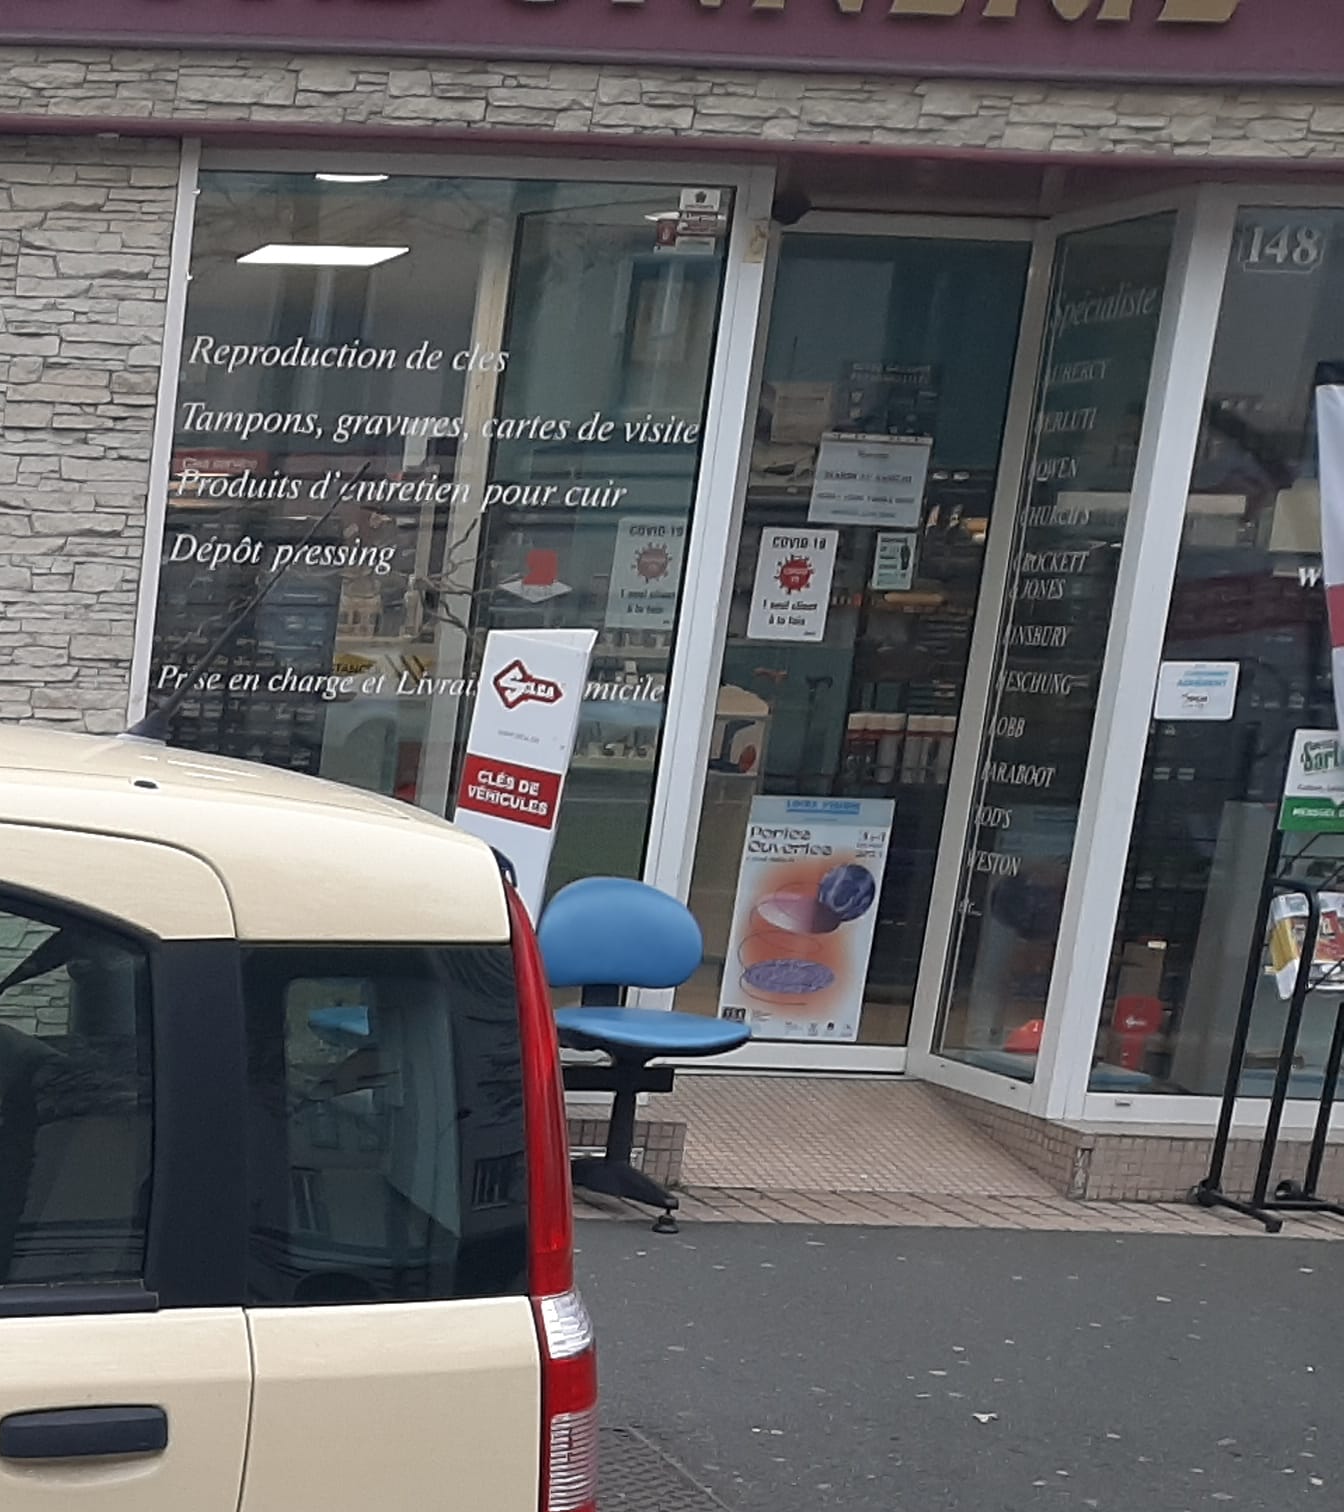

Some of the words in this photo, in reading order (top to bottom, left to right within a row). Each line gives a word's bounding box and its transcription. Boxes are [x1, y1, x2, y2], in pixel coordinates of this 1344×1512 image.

[1249, 223, 1320, 265] 148
[189, 336, 396, 373] Reproduction
[406, 340, 442, 370] de
[1043, 359, 1110, 384] UBERCY
[182, 402, 323, 440] Tampons,
[333, 415, 469, 443] gravures,
[482, 414, 568, 441] cartes
[577, 410, 615, 442] de
[624, 413, 700, 444] visite
[178, 468, 300, 500] Produits
[312, 470, 469, 503] d'entretien
[481, 482, 557, 513] pour
[565, 480, 627, 508] cuir
[170, 532, 263, 571] Dépôt
[271, 539, 396, 576] pressing
[1021, 577, 1066, 600] JONES
[157, 663, 223, 690] Prse
[228, 673, 259, 692] en
[268, 668, 354, 700] charge
[361, 672, 386, 695] et
[583, 677, 665, 703] micile
[518, 779, 540, 796] DE
